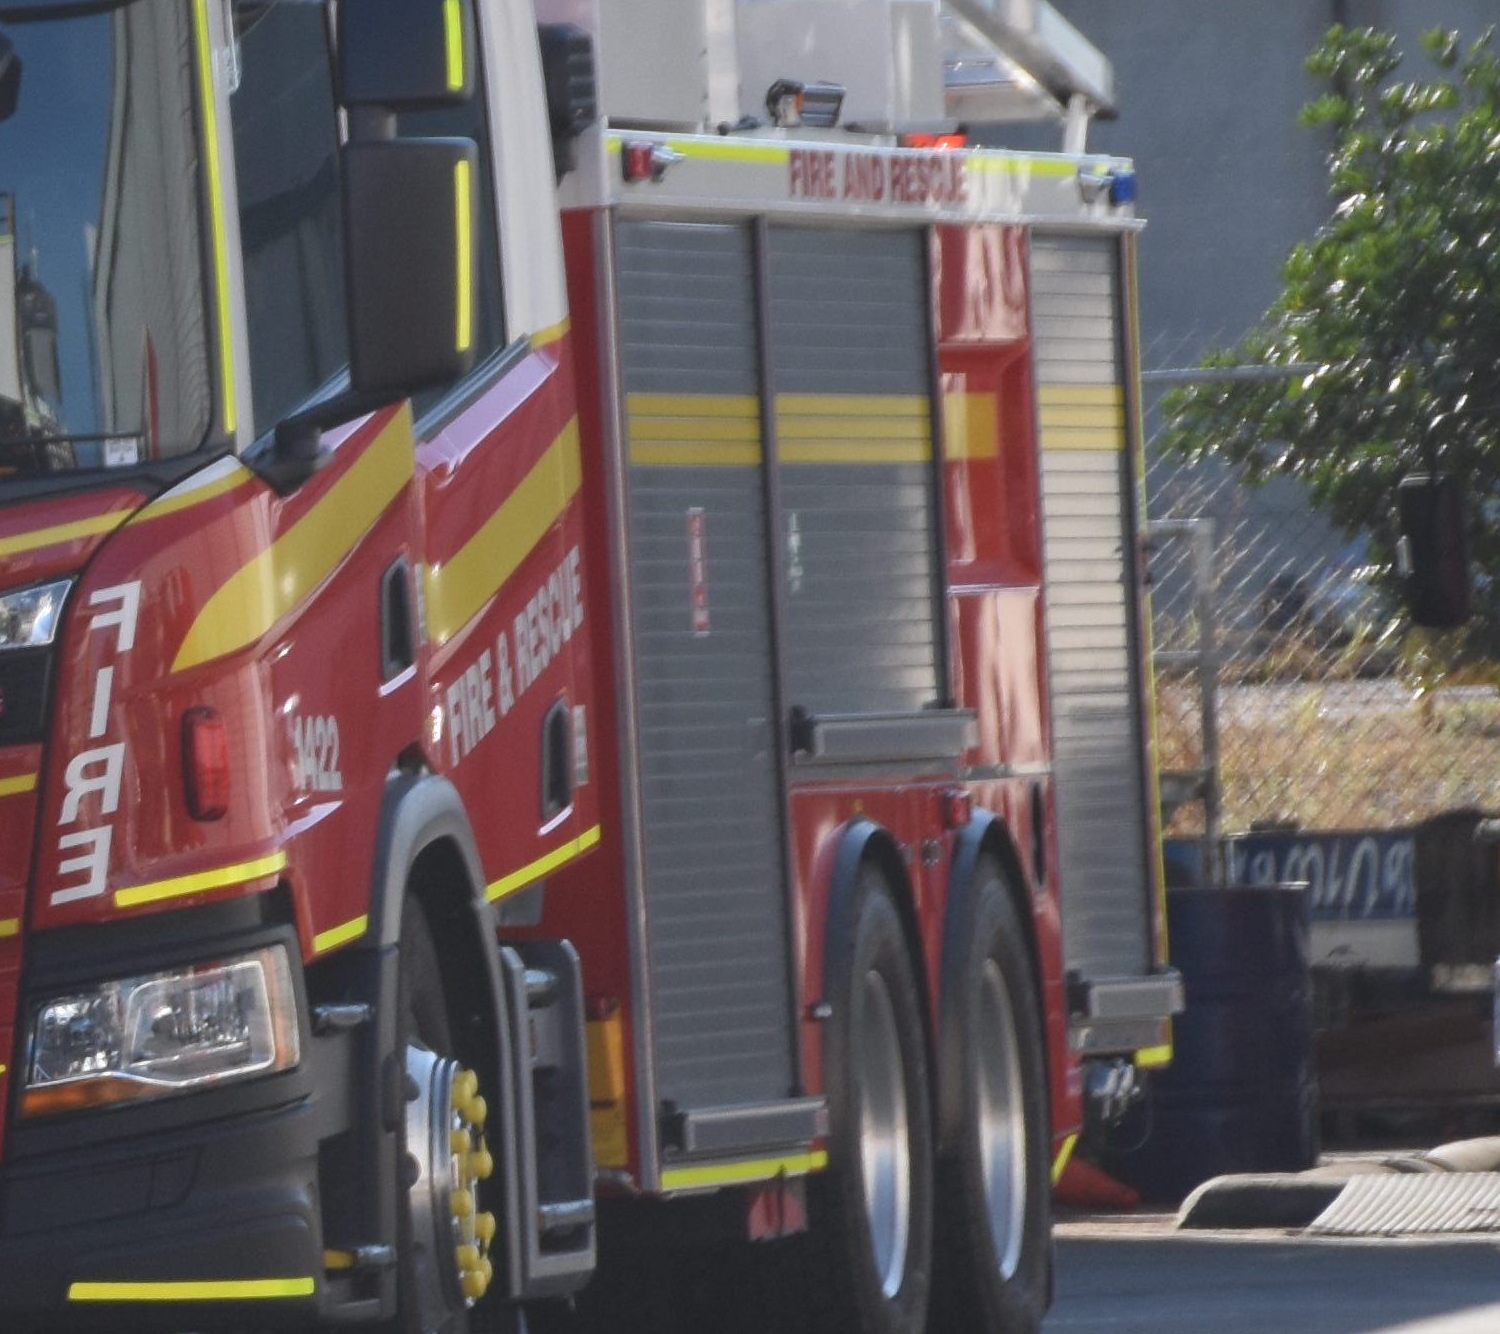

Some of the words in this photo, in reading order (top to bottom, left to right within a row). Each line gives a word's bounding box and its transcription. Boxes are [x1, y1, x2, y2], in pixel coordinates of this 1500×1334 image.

[789, 148, 836, 199] FIRE
[844, 151, 886, 202] AND
[446, 647, 497, 768] FIRE
[496, 631, 515, 717] &
[513, 544, 584, 698] RESCUE
